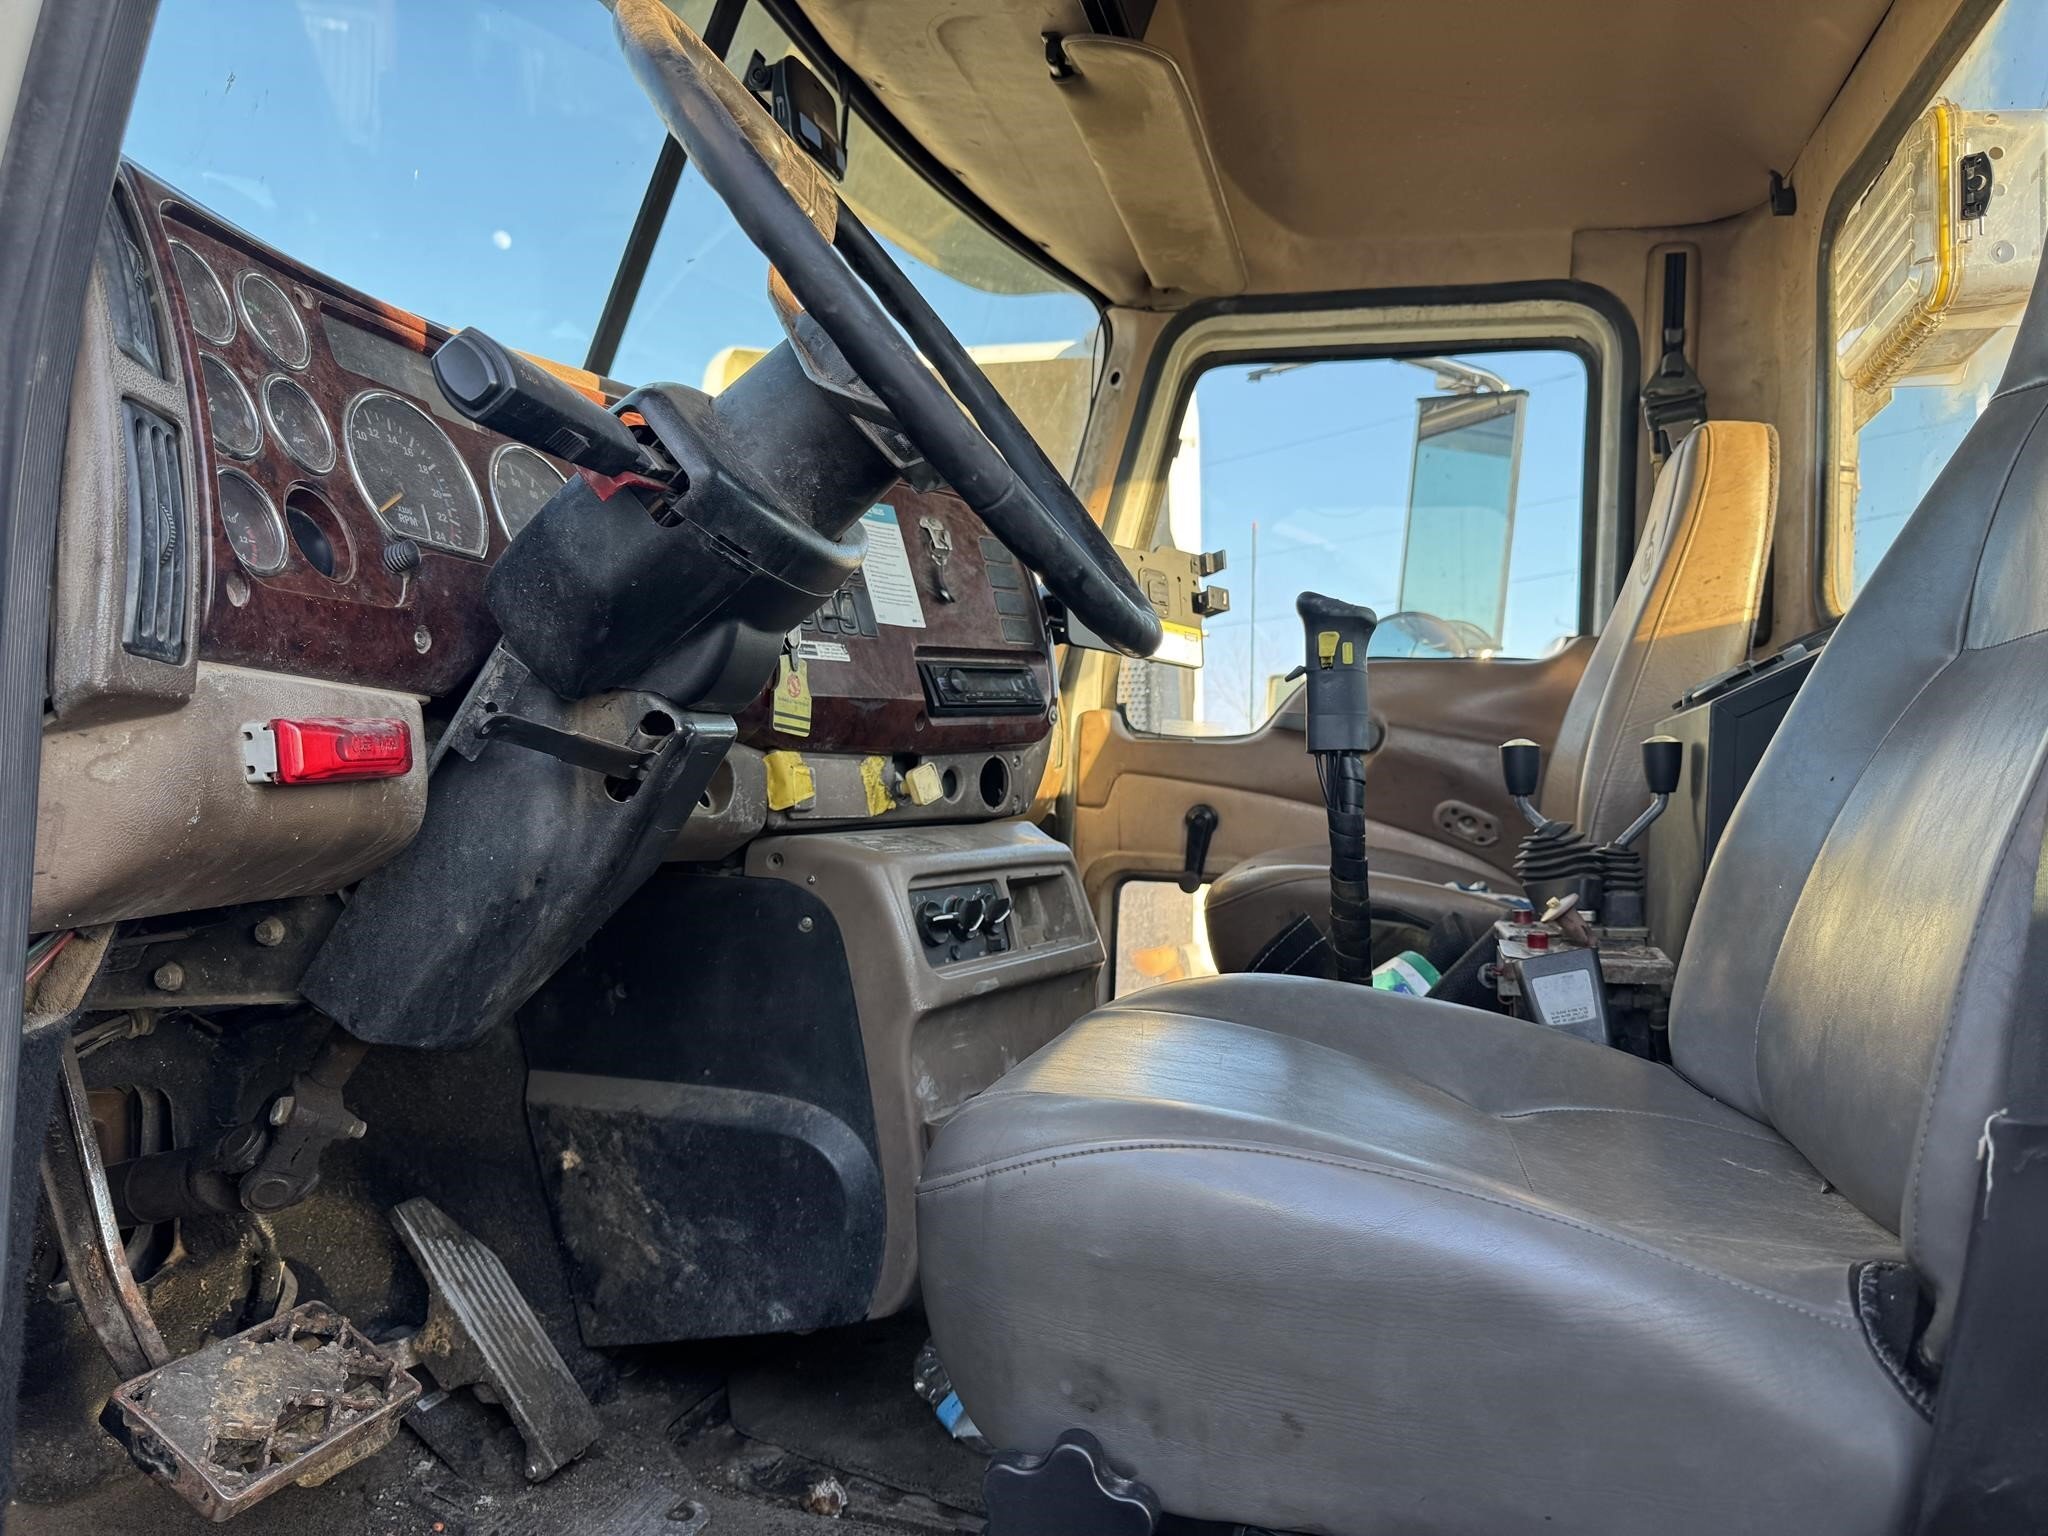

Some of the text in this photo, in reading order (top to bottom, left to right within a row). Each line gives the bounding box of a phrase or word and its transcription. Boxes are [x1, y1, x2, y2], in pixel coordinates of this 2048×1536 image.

[368, 427, 380, 439] 12
[398, 514, 418, 526] RPM
[437, 512, 448, 522] 22
